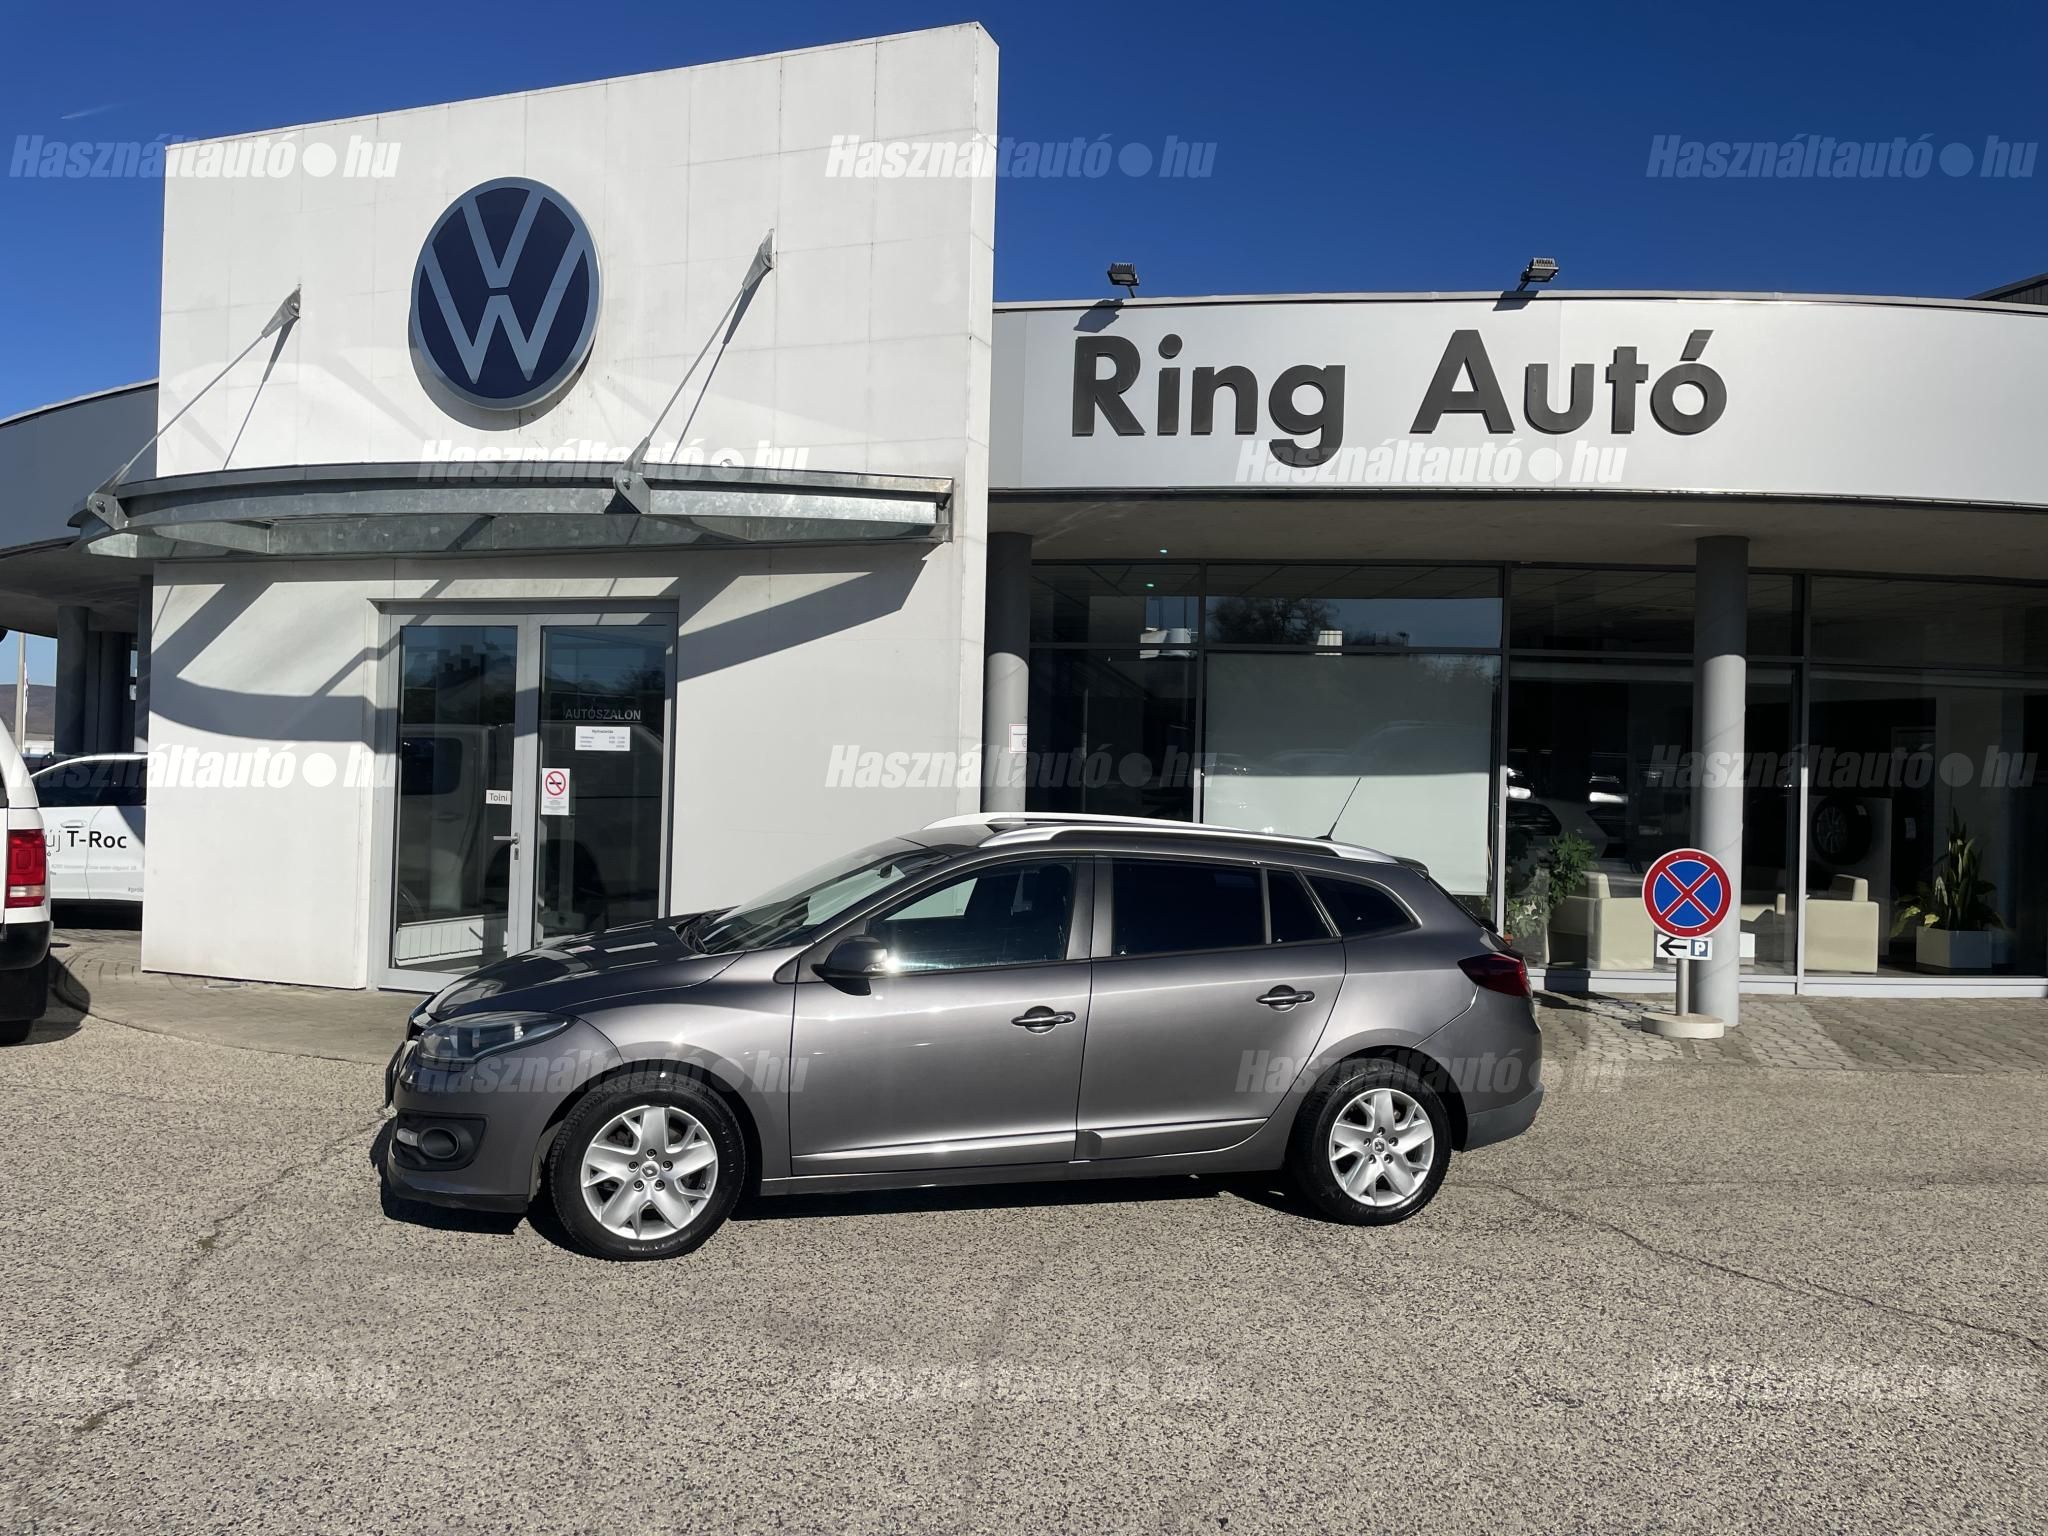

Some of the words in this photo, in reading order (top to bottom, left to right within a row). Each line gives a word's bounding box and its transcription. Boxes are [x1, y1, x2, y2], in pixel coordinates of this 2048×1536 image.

[1072, 333, 1346, 467] Ring
[1409, 329, 1727, 435] Autó
[565, 706, 641, 720] AUTÓSZALON
[489, 792, 508, 802] Tolni
[67, 830, 127, 849] T-Roc
[1694, 941, 1706, 956] P
